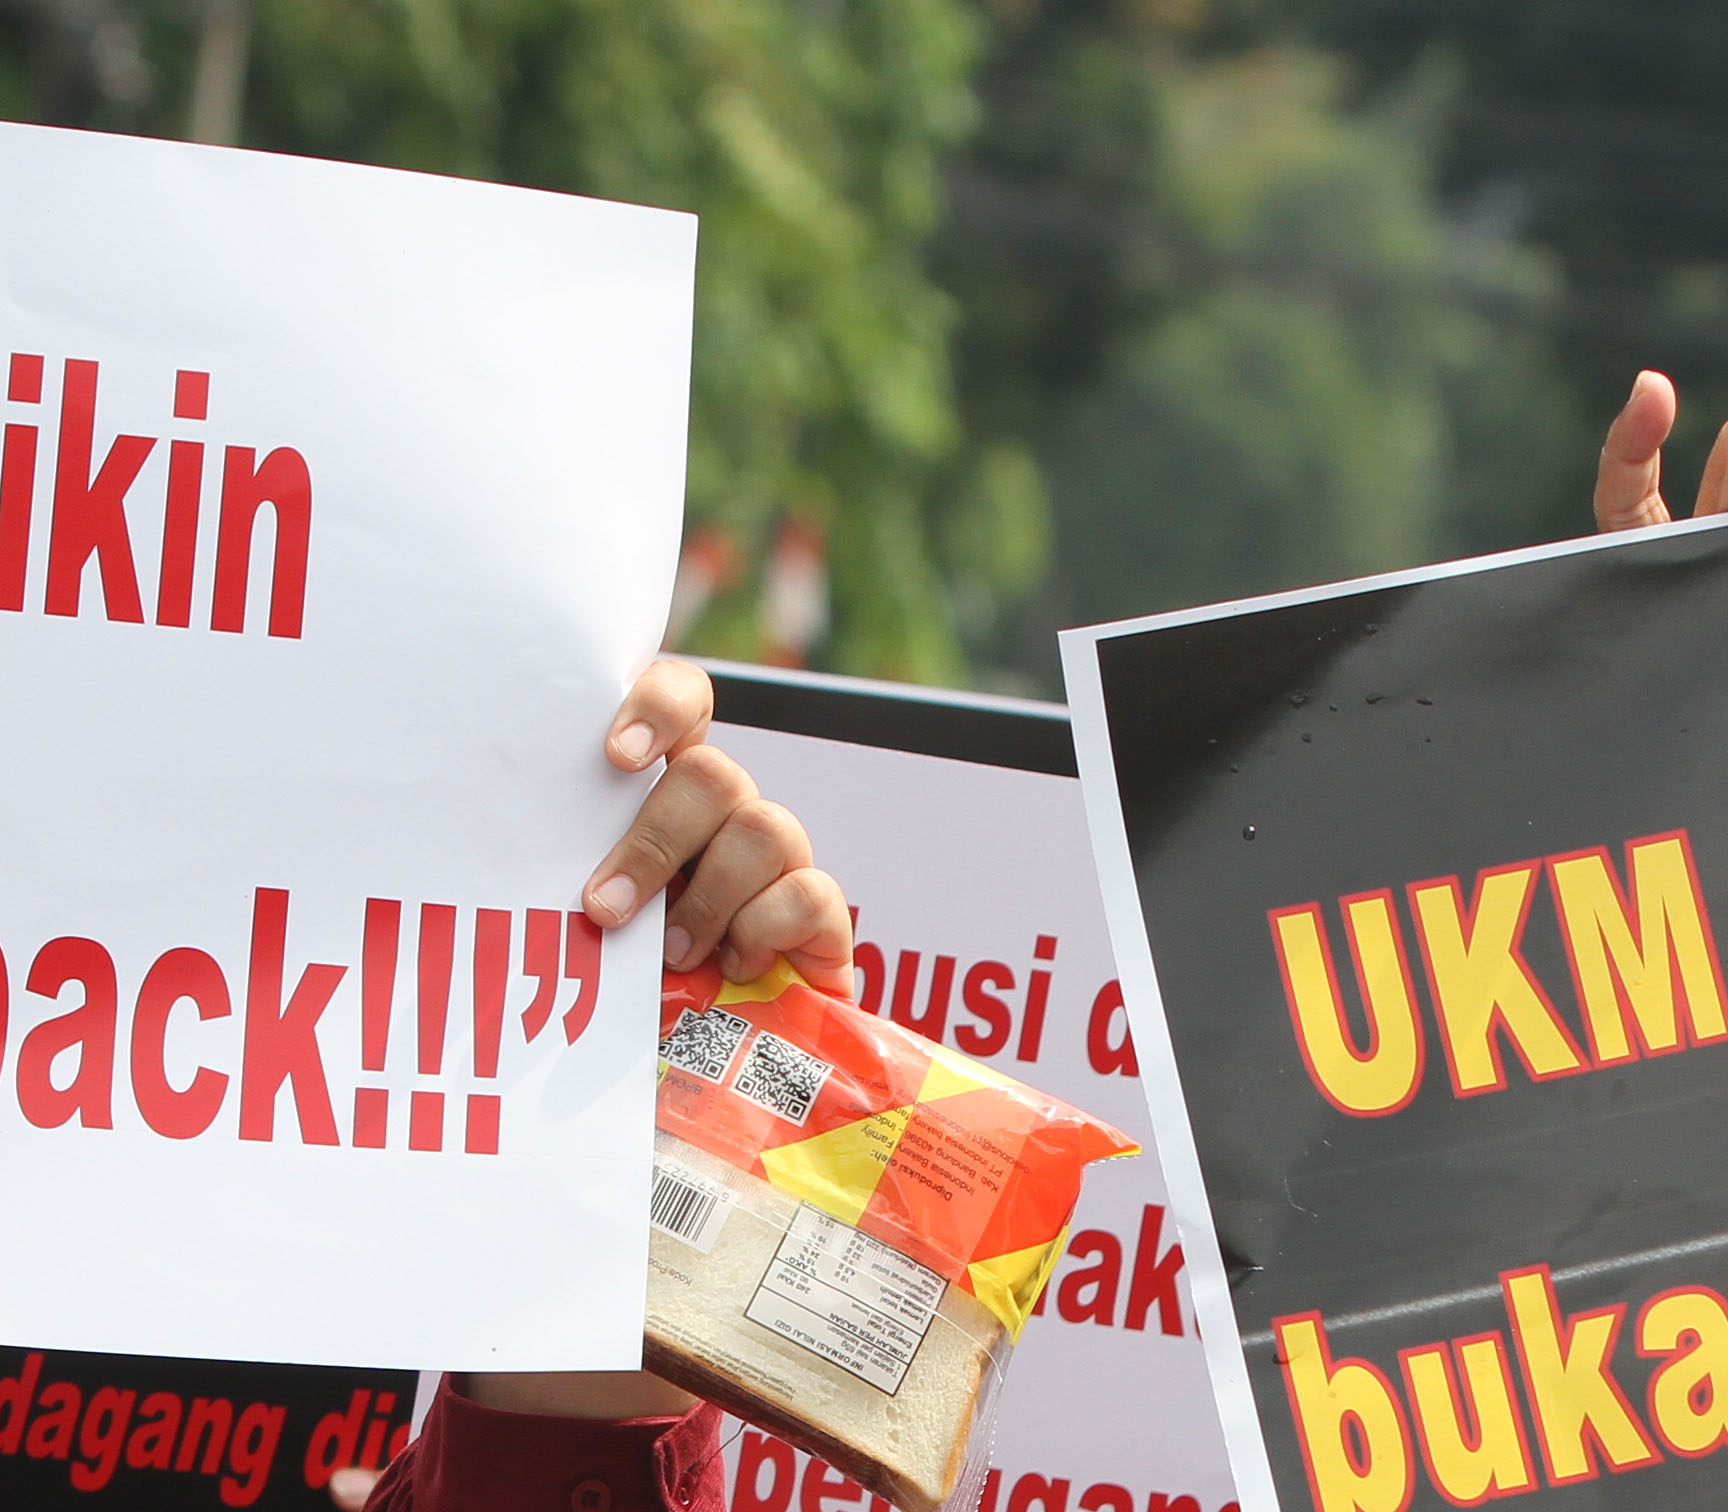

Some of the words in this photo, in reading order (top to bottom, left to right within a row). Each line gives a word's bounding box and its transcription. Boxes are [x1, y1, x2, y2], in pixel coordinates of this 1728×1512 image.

[859, 1122, 895, 1149] Family
[893, 1140, 931, 1168] Bakery
[932, 1146, 979, 1179] Bandung
[896, 1163, 954, 1201] Diproduksi
[927, 1162, 977, 1196] Indonesia
[988, 1163, 1004, 1177] PT
[773, 1318, 792, 1333] GIZI
[791, 1328, 816, 1345] NILAI
[815, 1340, 864, 1371] INFORMASI
